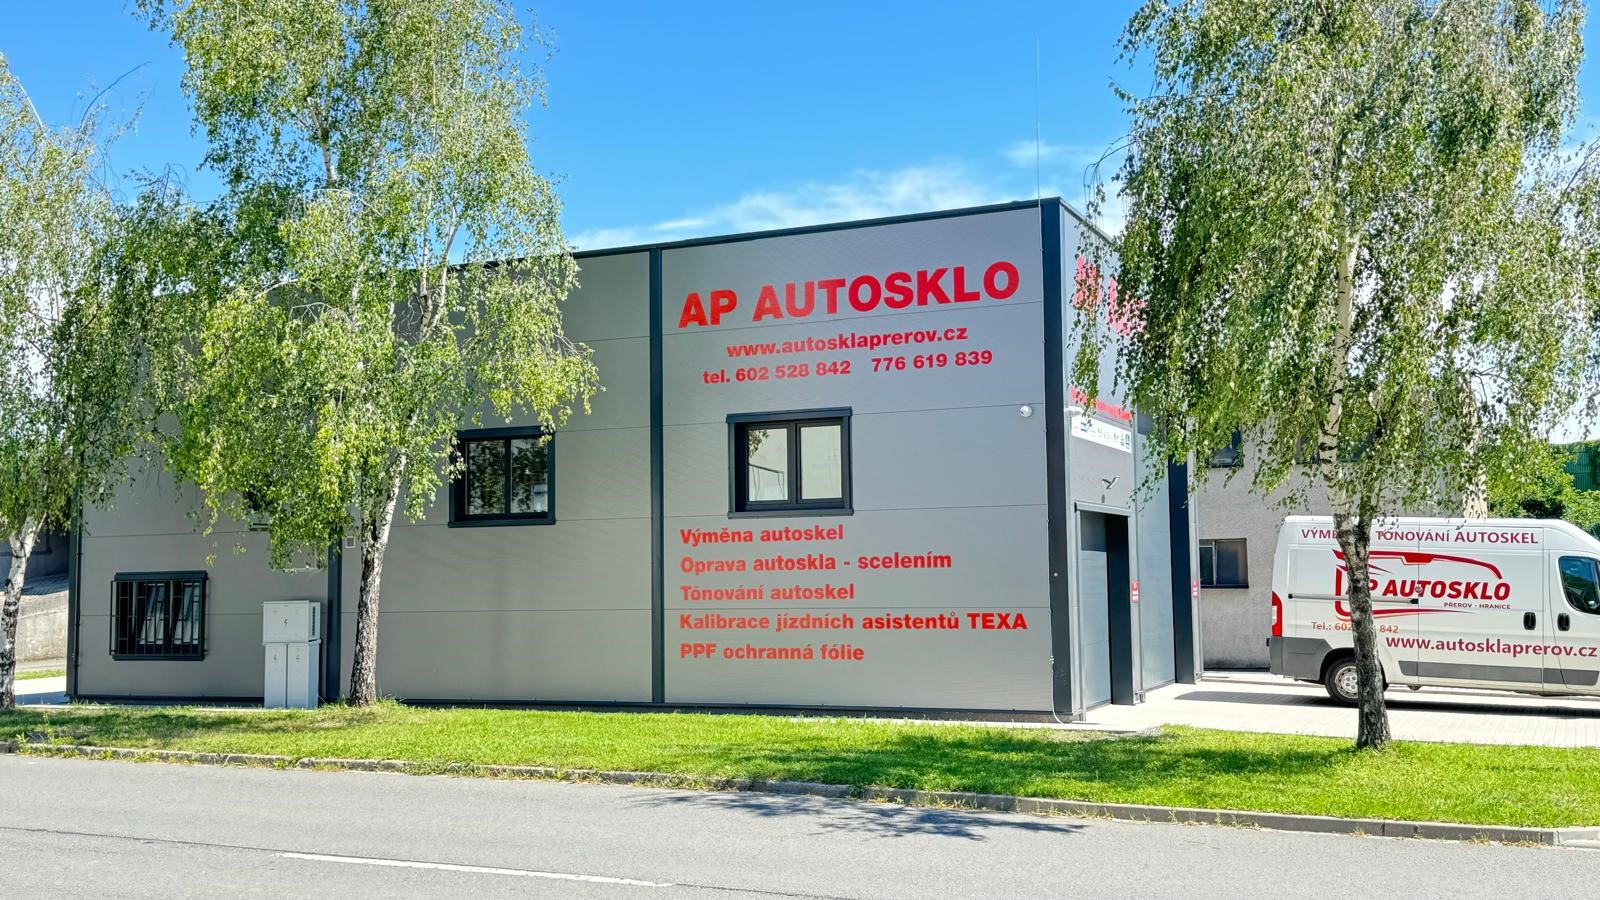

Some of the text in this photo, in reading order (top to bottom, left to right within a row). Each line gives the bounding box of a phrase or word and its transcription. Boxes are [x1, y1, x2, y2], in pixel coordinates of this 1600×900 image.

[677, 288, 738, 330] AP
[752, 260, 1020, 322] AUTOSKLO
[726, 327, 968, 358] www.autosklaprerov.cz
[703, 349, 993, 385] tel. 602 528 842 776 619 839
[680, 524, 844, 548] Výměna autoskel
[1454, 531, 1539, 544] AUTOSKEL
[680, 555, 746, 576] Oprava
[753, 552, 837, 571] autoskla
[857, 551, 953, 570] scelením
[680, 582, 855, 602] Tónování autoskel
[1382, 578, 1511, 602] AUTOSKLO
[679, 611, 1029, 633] Kalibrace jízdních asistentů TEXA
[1311, 621, 1332, 631] Tel.:
[1379, 624, 1399, 634] 842
[679, 642, 865, 661] PPF ochranná fólie
[1386, 636, 1598, 658] www.autosklaprerov.cz
